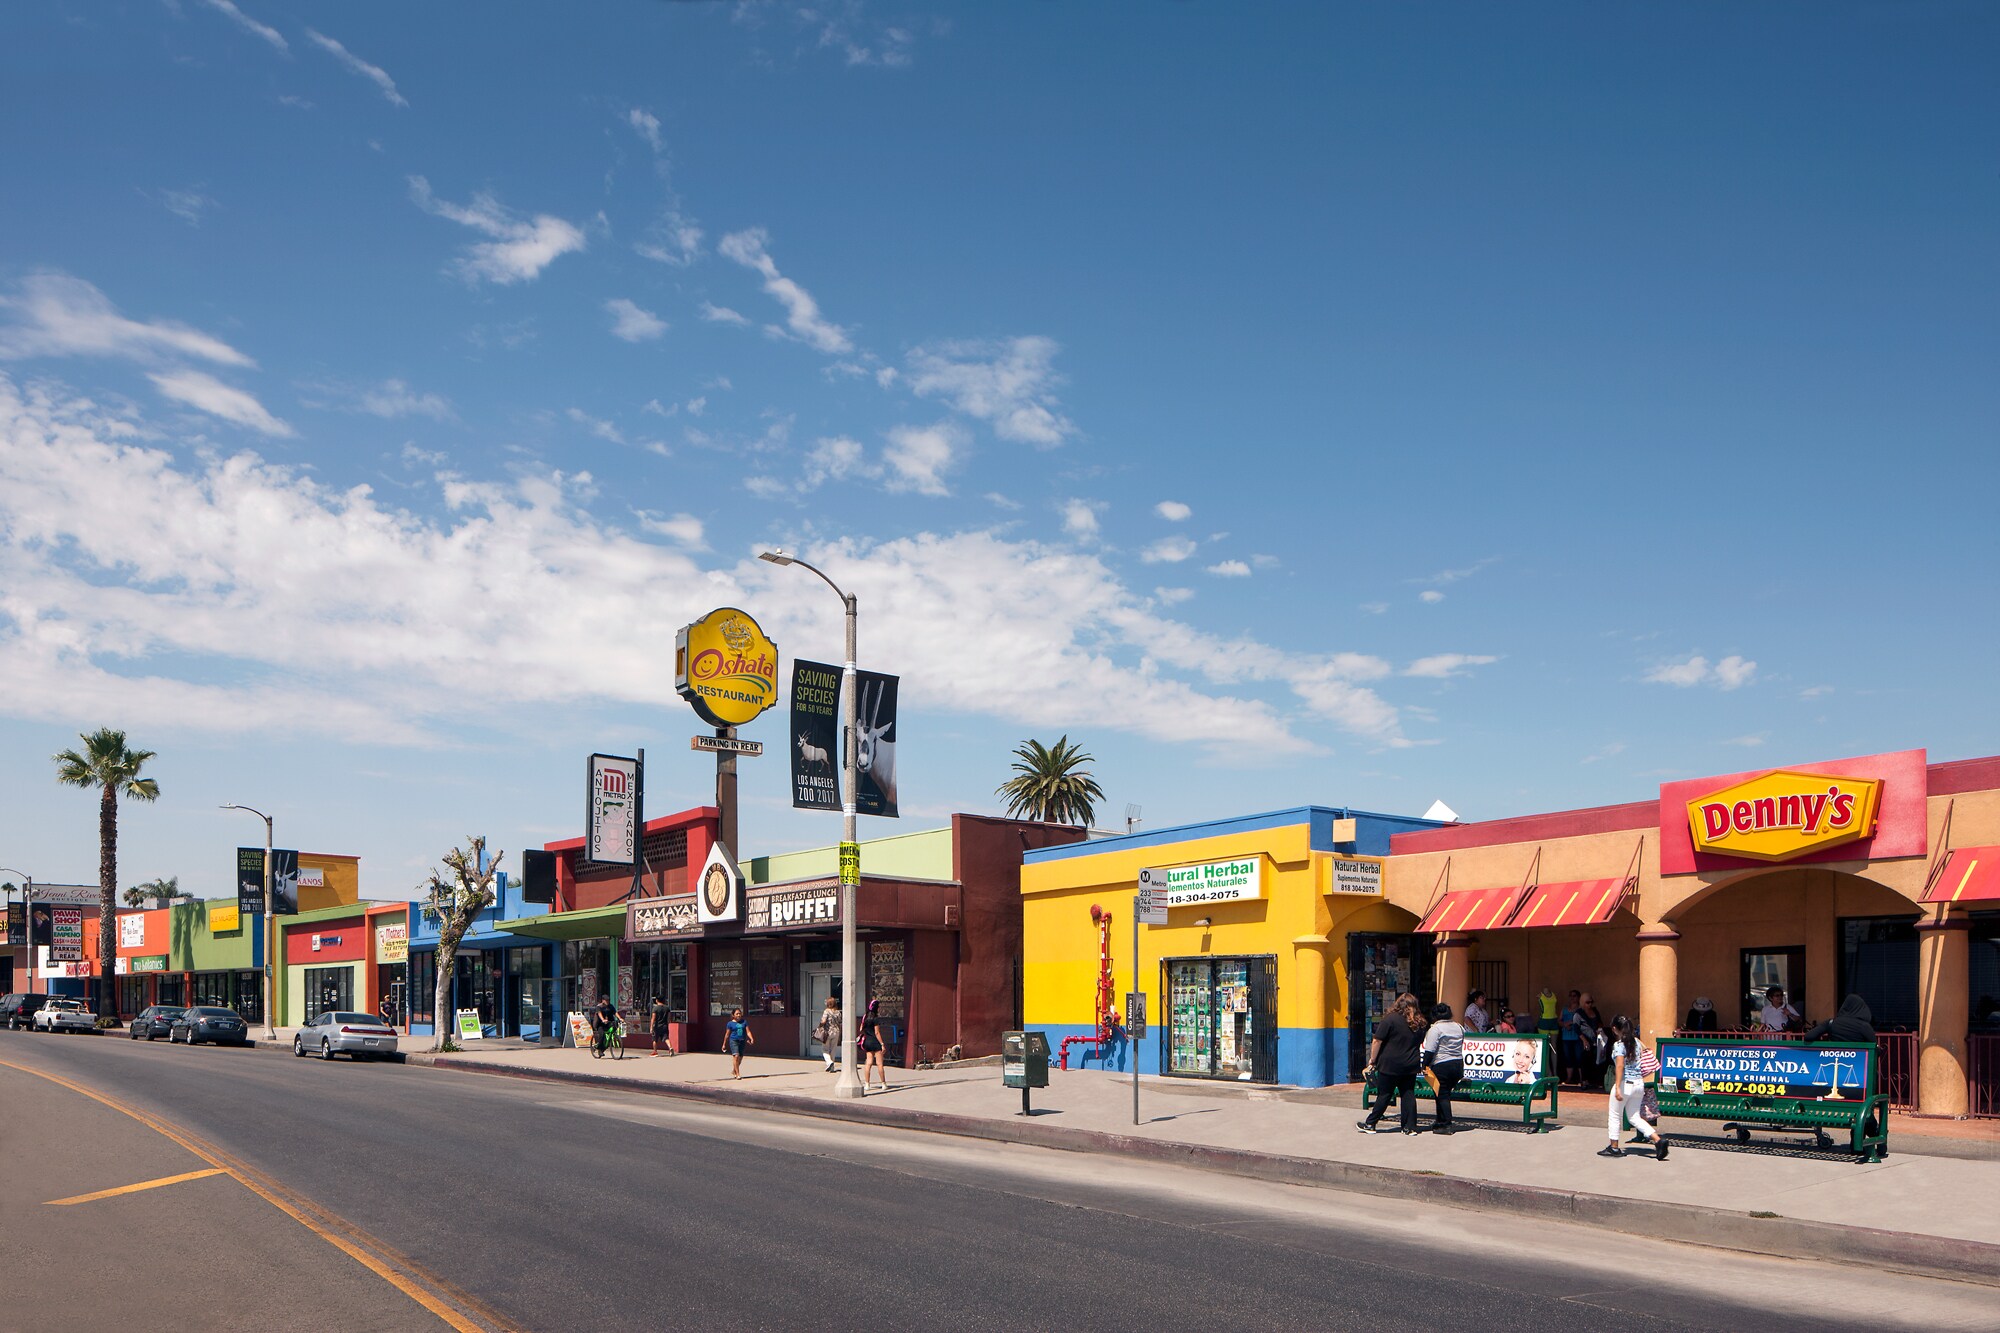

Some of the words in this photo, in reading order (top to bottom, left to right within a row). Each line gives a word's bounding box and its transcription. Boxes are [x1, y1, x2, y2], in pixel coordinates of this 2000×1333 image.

[692, 649, 774, 680] Oshata
[798, 669, 836, 689] SAVING
[697, 685, 764, 705] RESTAURANT
[797, 686, 834, 705] SPECIES
[797, 702, 807, 712] FOR
[816, 706, 832, 716] YEARS
[700, 738, 729, 748] PARKING
[732, 740, 738, 749] IN
[741, 742, 758, 751] REAR
[798, 775, 808, 784] LOS
[810, 776, 833, 788] ANGELES
[799, 787, 814, 801] ZOO
[818, 789, 834, 803] 2017
[626, 773, 634, 856] MEXICANOS
[1702, 786, 1855, 841] Denny's
[1205, 862, 1253, 878] Herbal
[1335, 861, 1358, 872] Natural
[1360, 863, 1380, 874] Herbal
[1208, 877, 1247, 888] Naturales
[41, 888, 67, 899] Jenni
[772, 892, 806, 902] BREAKFAST
[813, 889, 836, 898] LUNCH
[1167, 890, 1238, 903] 18-304-2075
[771, 897, 836, 921] BUFFET
[749, 912, 769, 928] SUNDAY
[1128, 1021, 1132, 1030] Go
[1464, 1054, 1504, 1067] 0306
[1697, 1049, 1718, 1058] LAW
[1720, 1050, 1760, 1059] OFFICES
[1763, 1051, 1776, 1059] OF
[1666, 1057, 1736, 1071] RICHARD
[1739, 1059, 1760, 1072] DE
[1764, 1060, 1810, 1074] ANDA
[1682, 1072, 1731, 1080] ACCIDENTS
[1744, 1075, 1790, 1083] CRIMINAL
[1685, 1081, 1786, 1095] 88-407-0034
